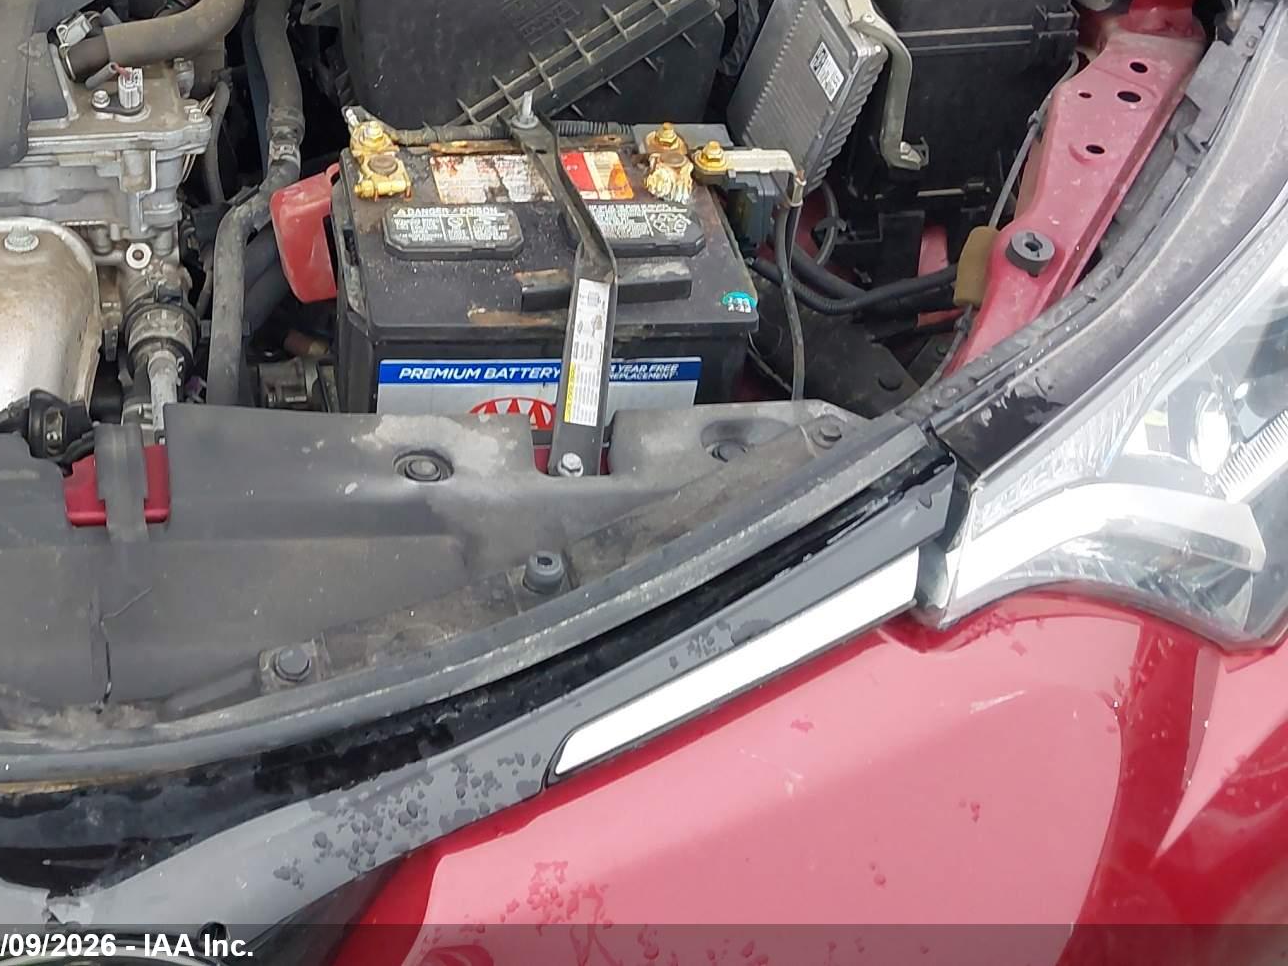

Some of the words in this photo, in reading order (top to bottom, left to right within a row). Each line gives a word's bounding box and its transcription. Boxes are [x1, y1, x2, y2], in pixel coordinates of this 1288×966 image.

[399, 367, 481, 379] PREMIUM
[483, 366, 561, 379] BATTERY
[618, 364, 648, 374] YEAR
[648, 364, 680, 374] FREE
